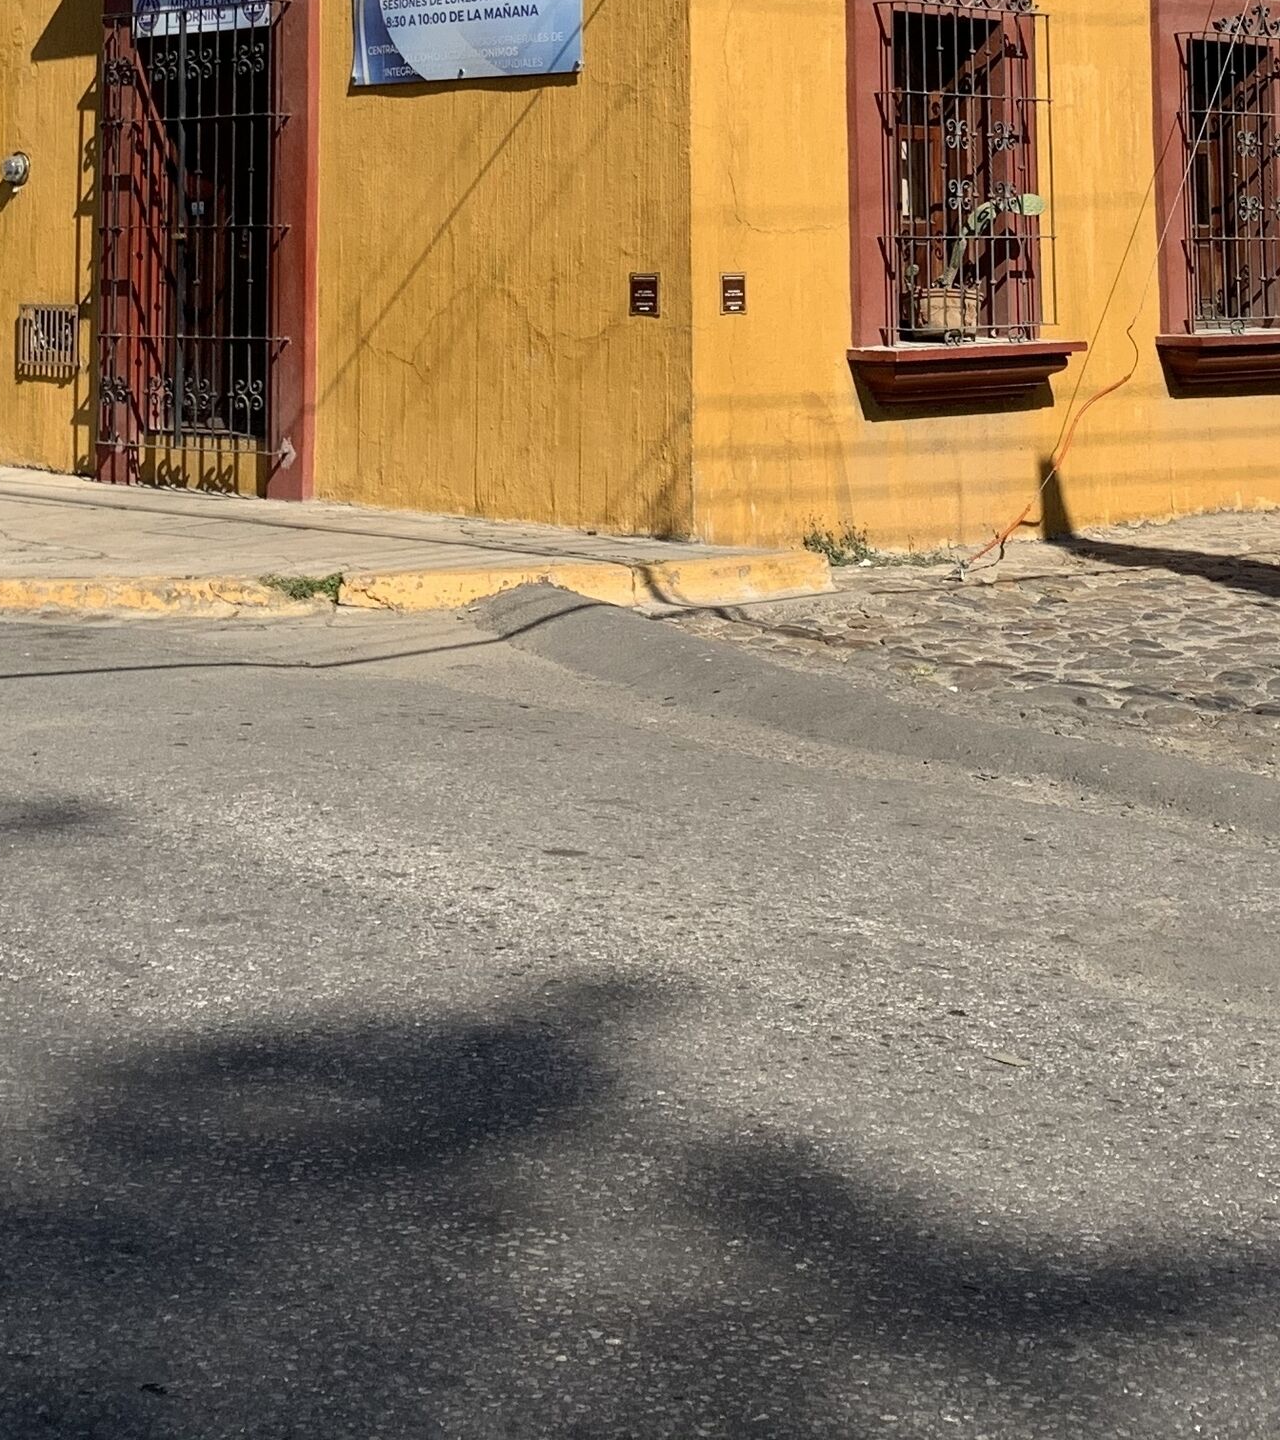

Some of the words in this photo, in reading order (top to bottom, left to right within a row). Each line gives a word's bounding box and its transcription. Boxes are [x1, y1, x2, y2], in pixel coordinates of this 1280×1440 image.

[385, 15, 407, 29] 8:30
[408, 14, 416, 26] A
[417, 12, 447, 26] 10:00
[449, 10, 465, 23] DE
[467, 8, 482, 21] LA
[484, 3, 539, 20] MAÑANA
